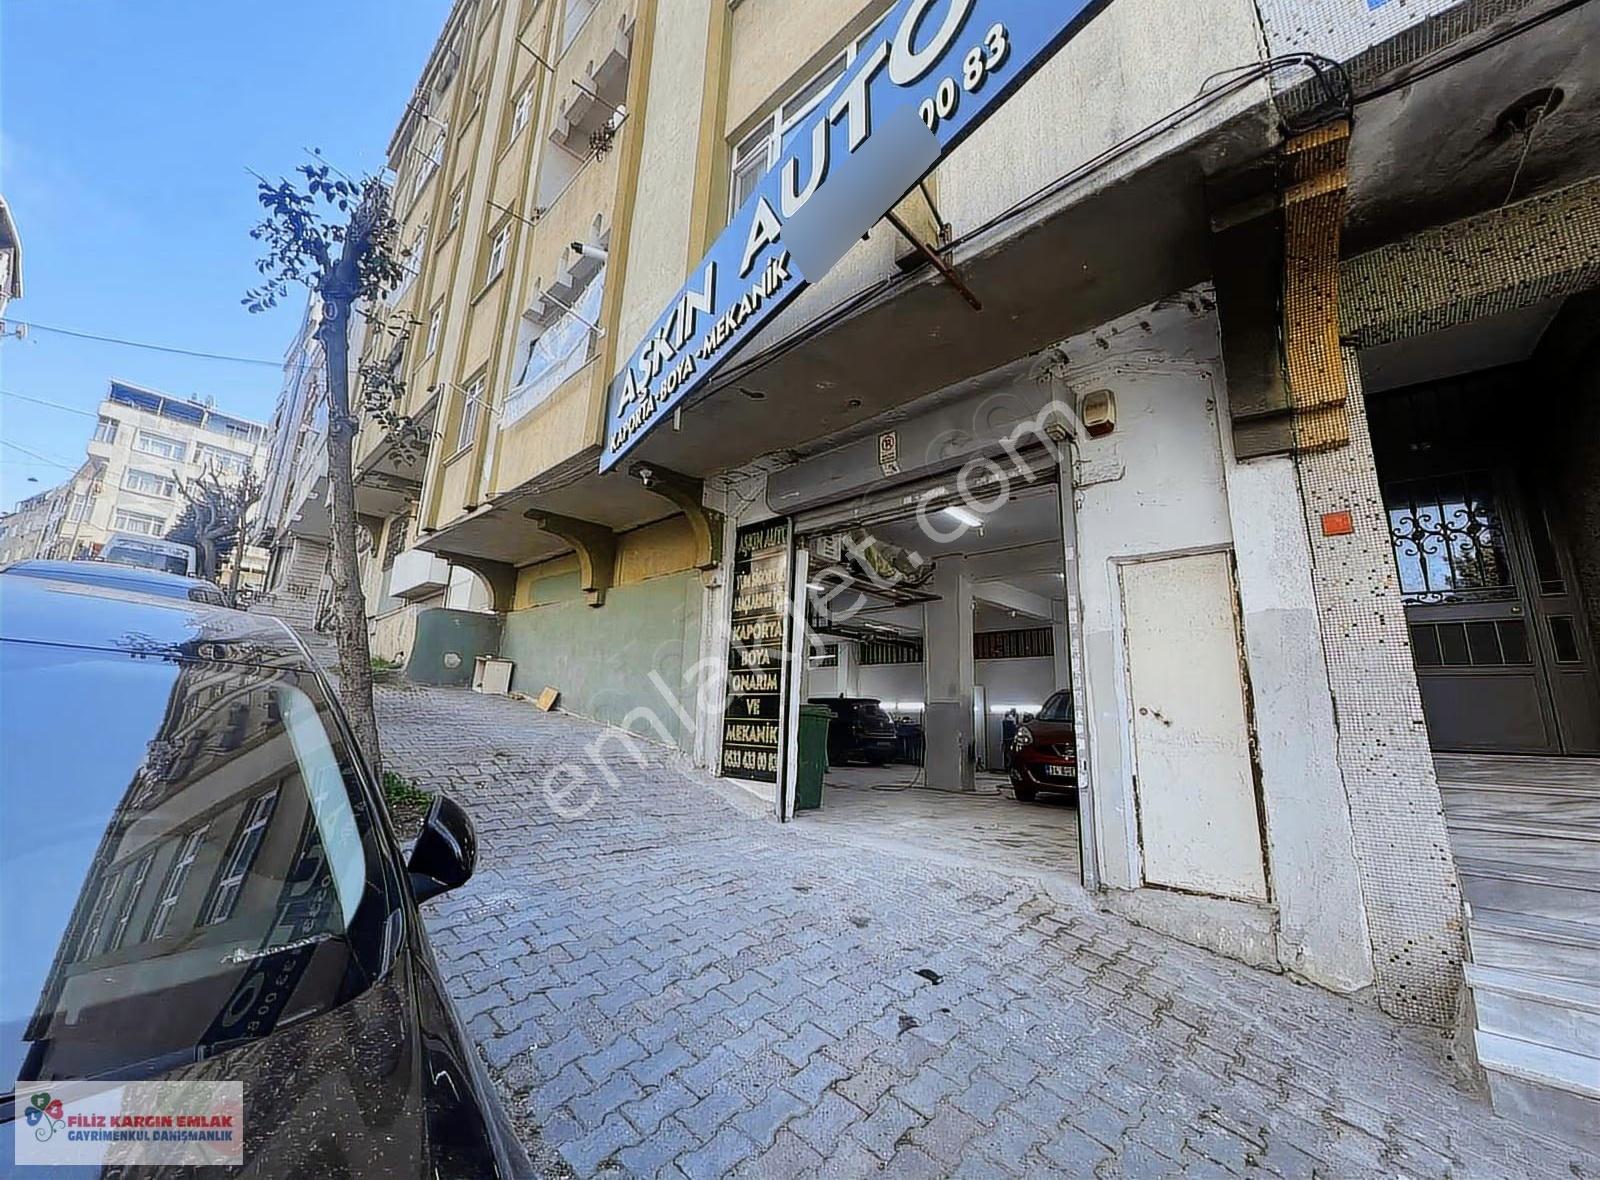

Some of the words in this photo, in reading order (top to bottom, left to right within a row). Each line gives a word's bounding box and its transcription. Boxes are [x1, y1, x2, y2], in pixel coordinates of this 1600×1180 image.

[963, 23, 1011, 93] 83
[617, 261, 717, 418] AŞKIN
[739, 0, 977, 279] AUTO
[609, 394, 656, 454] KAPORTA
[732, 620, 782, 641] KAPORTA
[741, 649, 771, 666] BOYA
[746, 698, 760, 716] VE
[725, 722, 778, 744] MEKANİK
